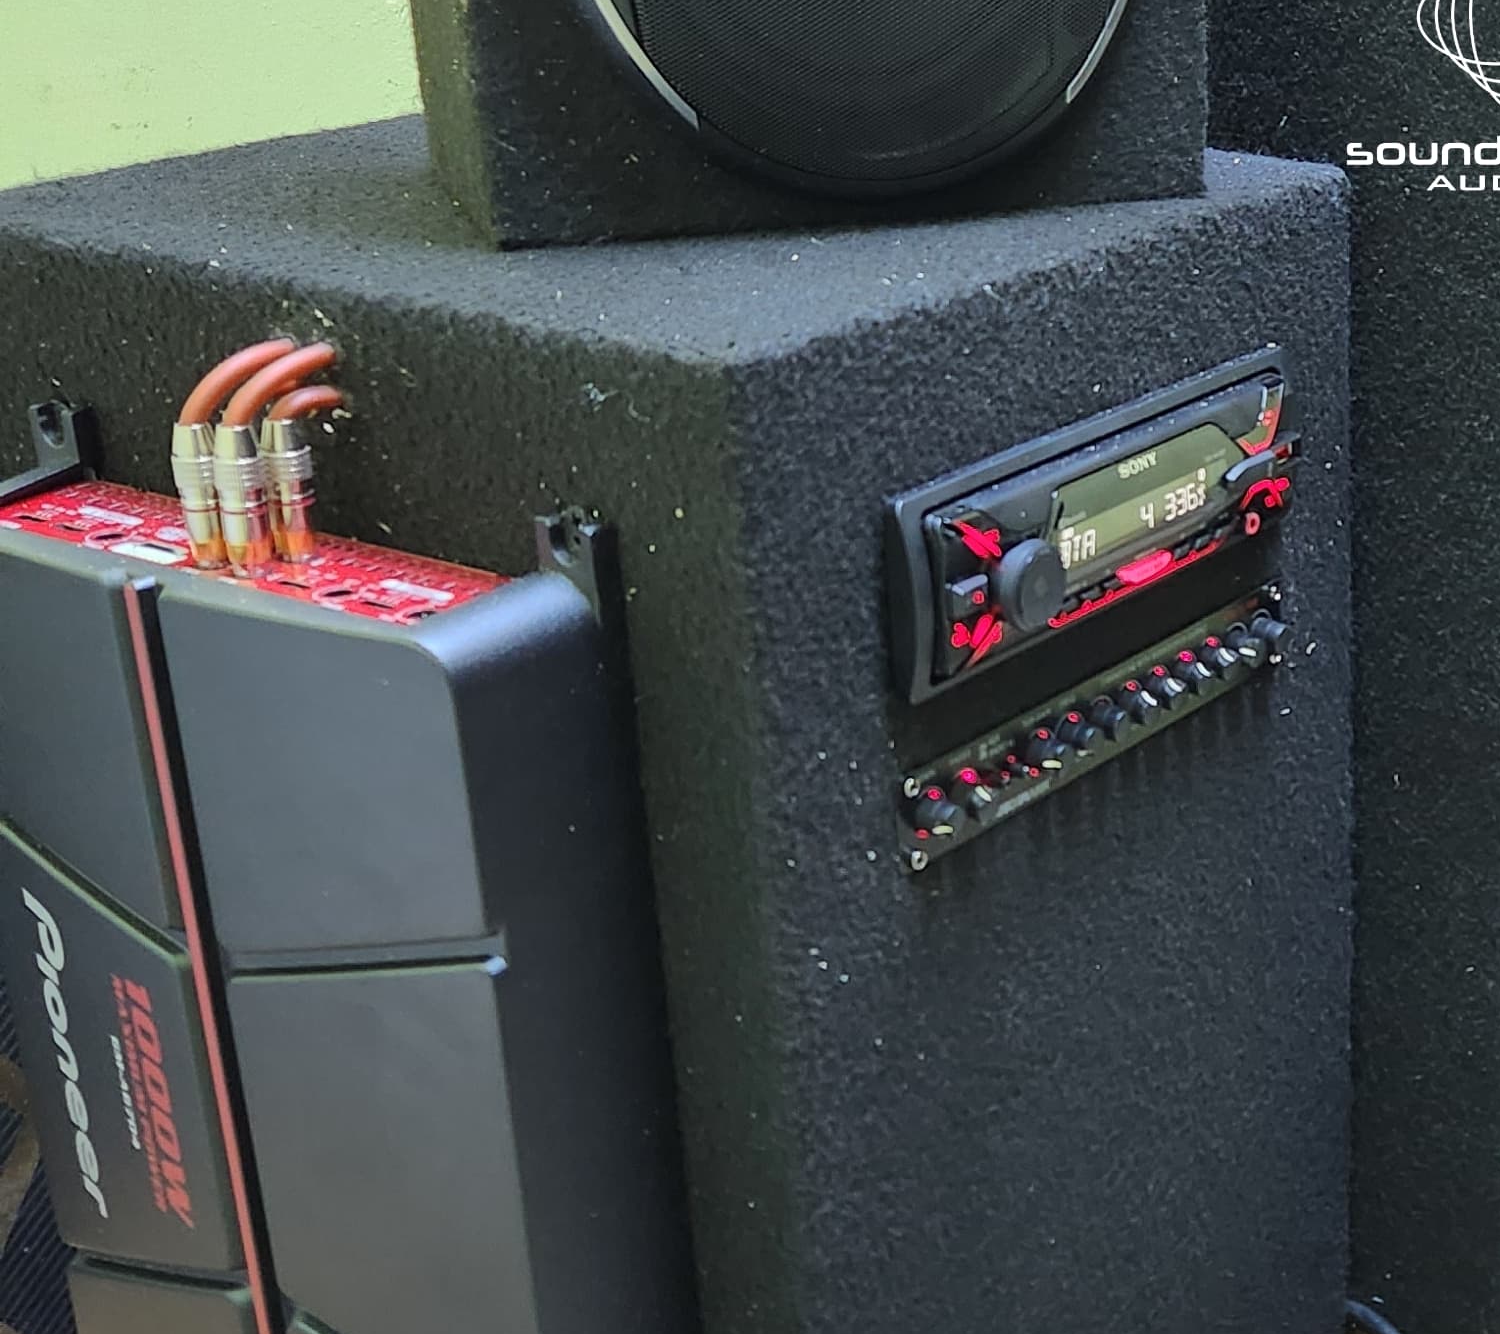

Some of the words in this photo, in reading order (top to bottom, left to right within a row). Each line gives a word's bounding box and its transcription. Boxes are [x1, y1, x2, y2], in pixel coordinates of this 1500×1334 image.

[1117, 450, 1158, 479] SONY
[21, 887, 109, 1218] Pioneer
[122, 977, 195, 1229] 1000W
